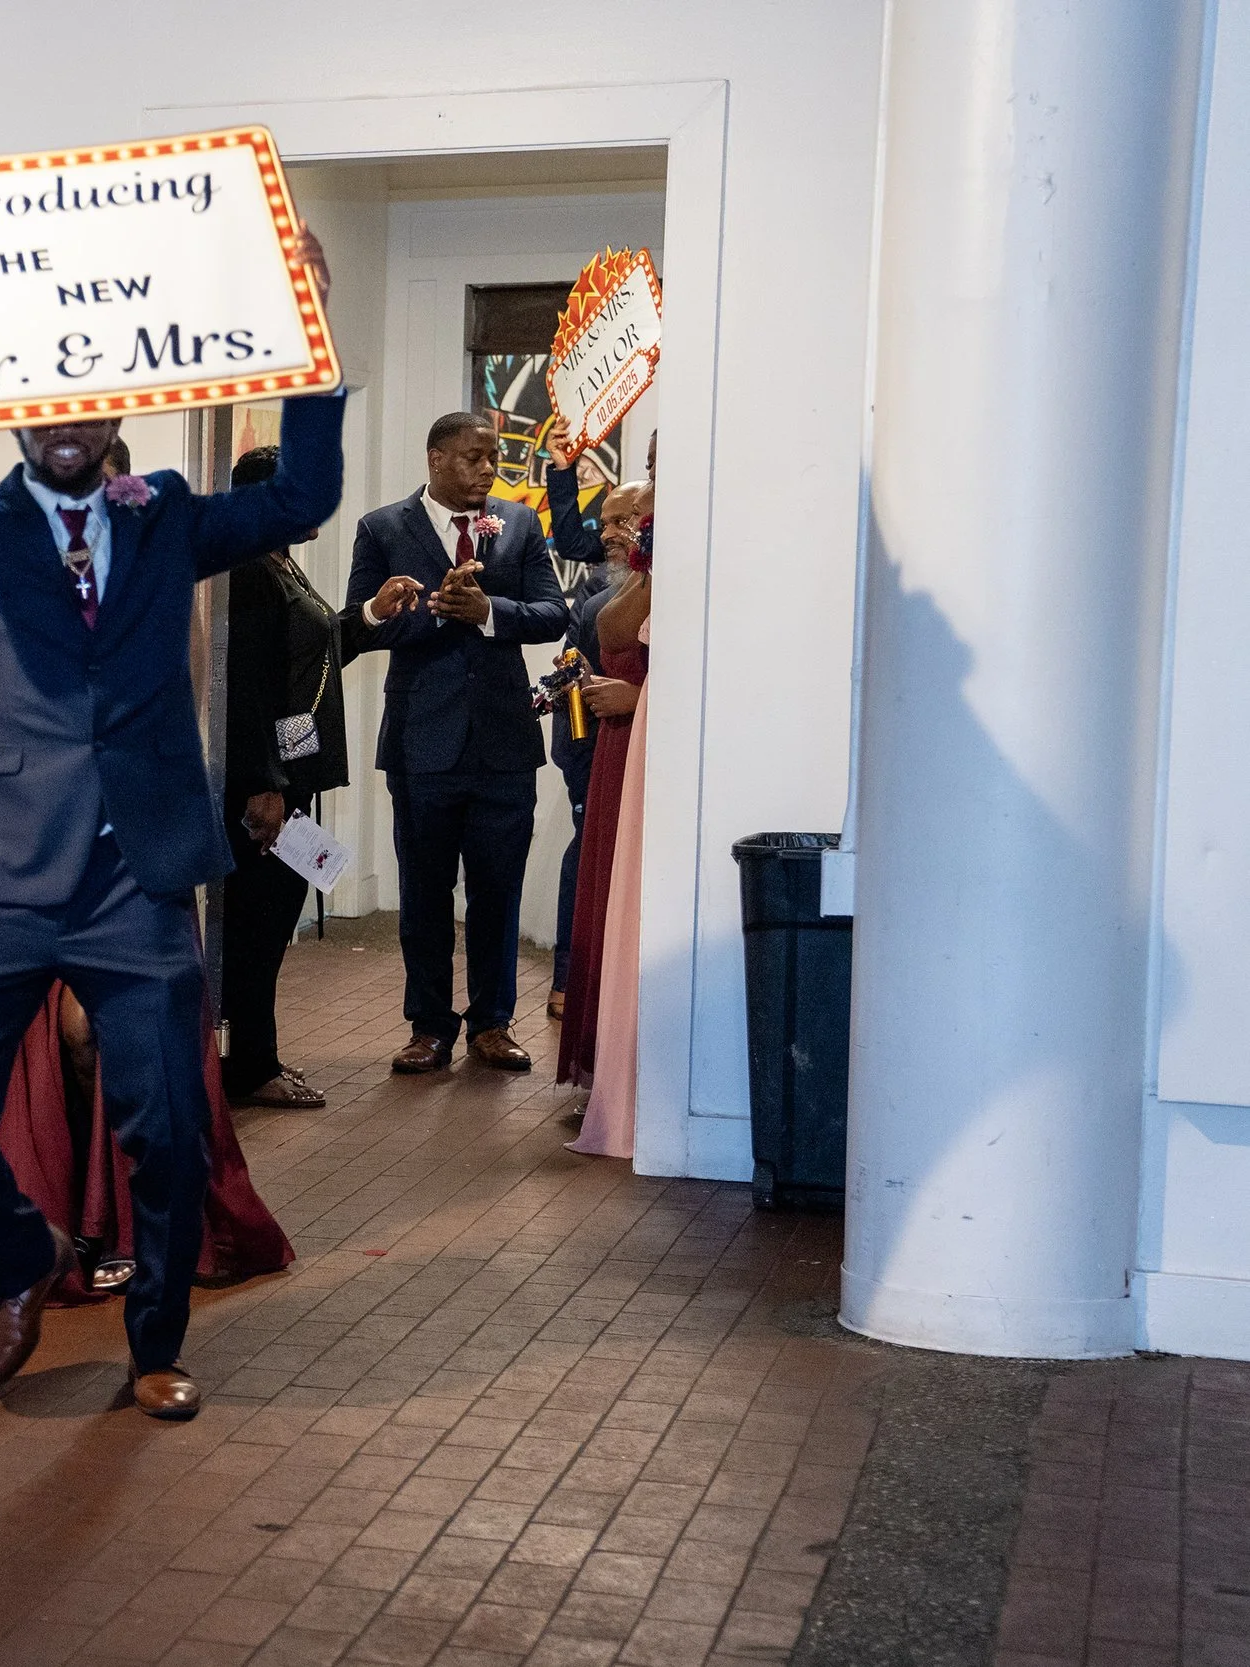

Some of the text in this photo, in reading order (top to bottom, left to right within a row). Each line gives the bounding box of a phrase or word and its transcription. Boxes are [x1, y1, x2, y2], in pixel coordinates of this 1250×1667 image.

[57, 275, 152, 306] NEW
[56, 333, 104, 379] &
[122, 323, 273, 375] Mrs.
[560, 282, 635, 381] MR. & MRS.
[575, 323, 640, 408] TAYLOR
[596, 369, 639, 426] 10.05.2025
